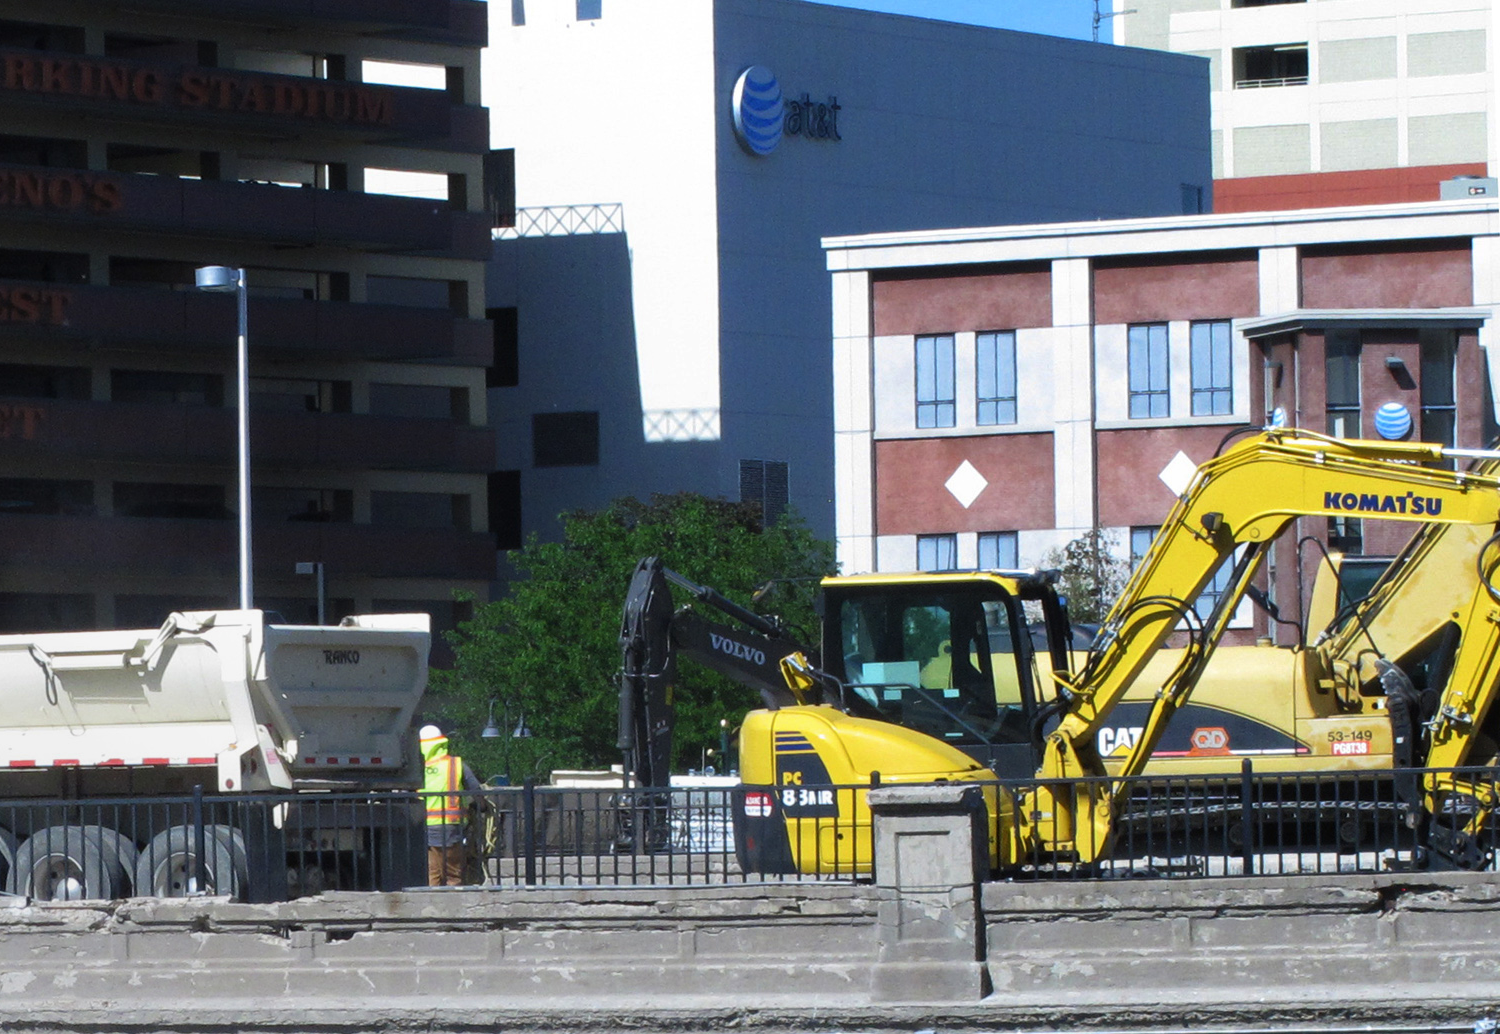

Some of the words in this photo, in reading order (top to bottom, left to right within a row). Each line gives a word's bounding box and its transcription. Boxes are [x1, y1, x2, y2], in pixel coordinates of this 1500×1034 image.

[179, 68, 392, 124] STADIUM
[784, 92, 842, 141] at&t
[1324, 491, 1442, 515] KOMATSU
[709, 632, 766, 665] VOLVO
[1098, 727, 1144, 757] CAT
[1328, 730, 1372, 742] 53-149
[782, 772, 802, 786] PC
